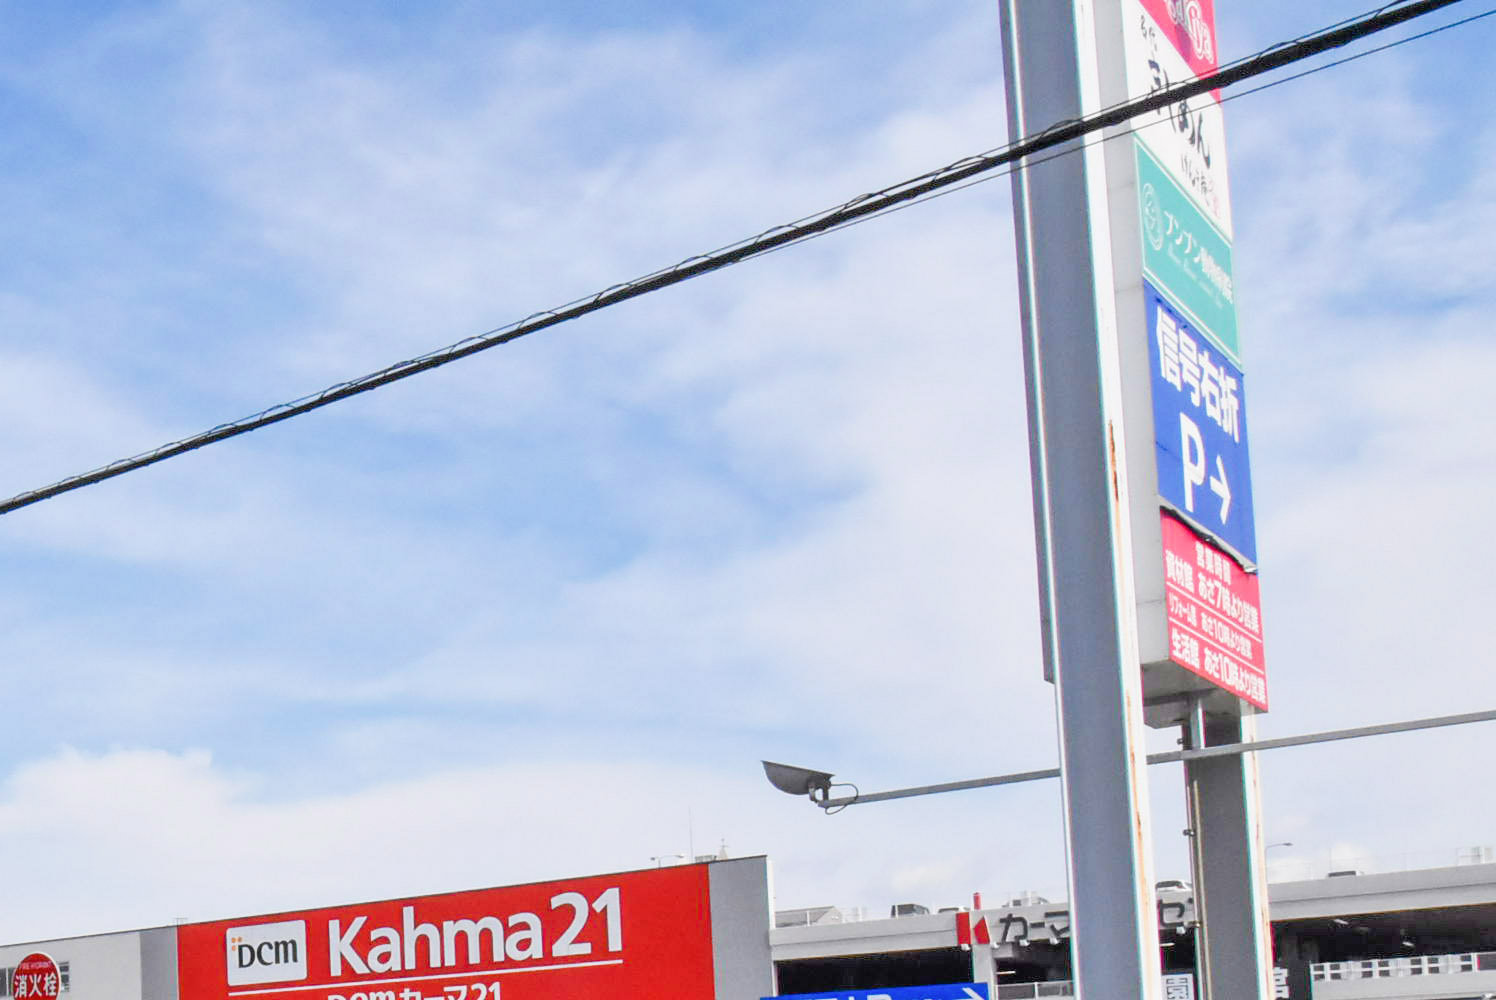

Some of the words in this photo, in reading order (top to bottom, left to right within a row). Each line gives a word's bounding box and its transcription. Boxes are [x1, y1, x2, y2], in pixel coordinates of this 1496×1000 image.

[1156, 305, 1240, 443] 信号右折
[1179, 411, 1206, 513] P
[1172, 627, 1200, 669] 生活館
[14, 973, 57, 998] 消火栓
